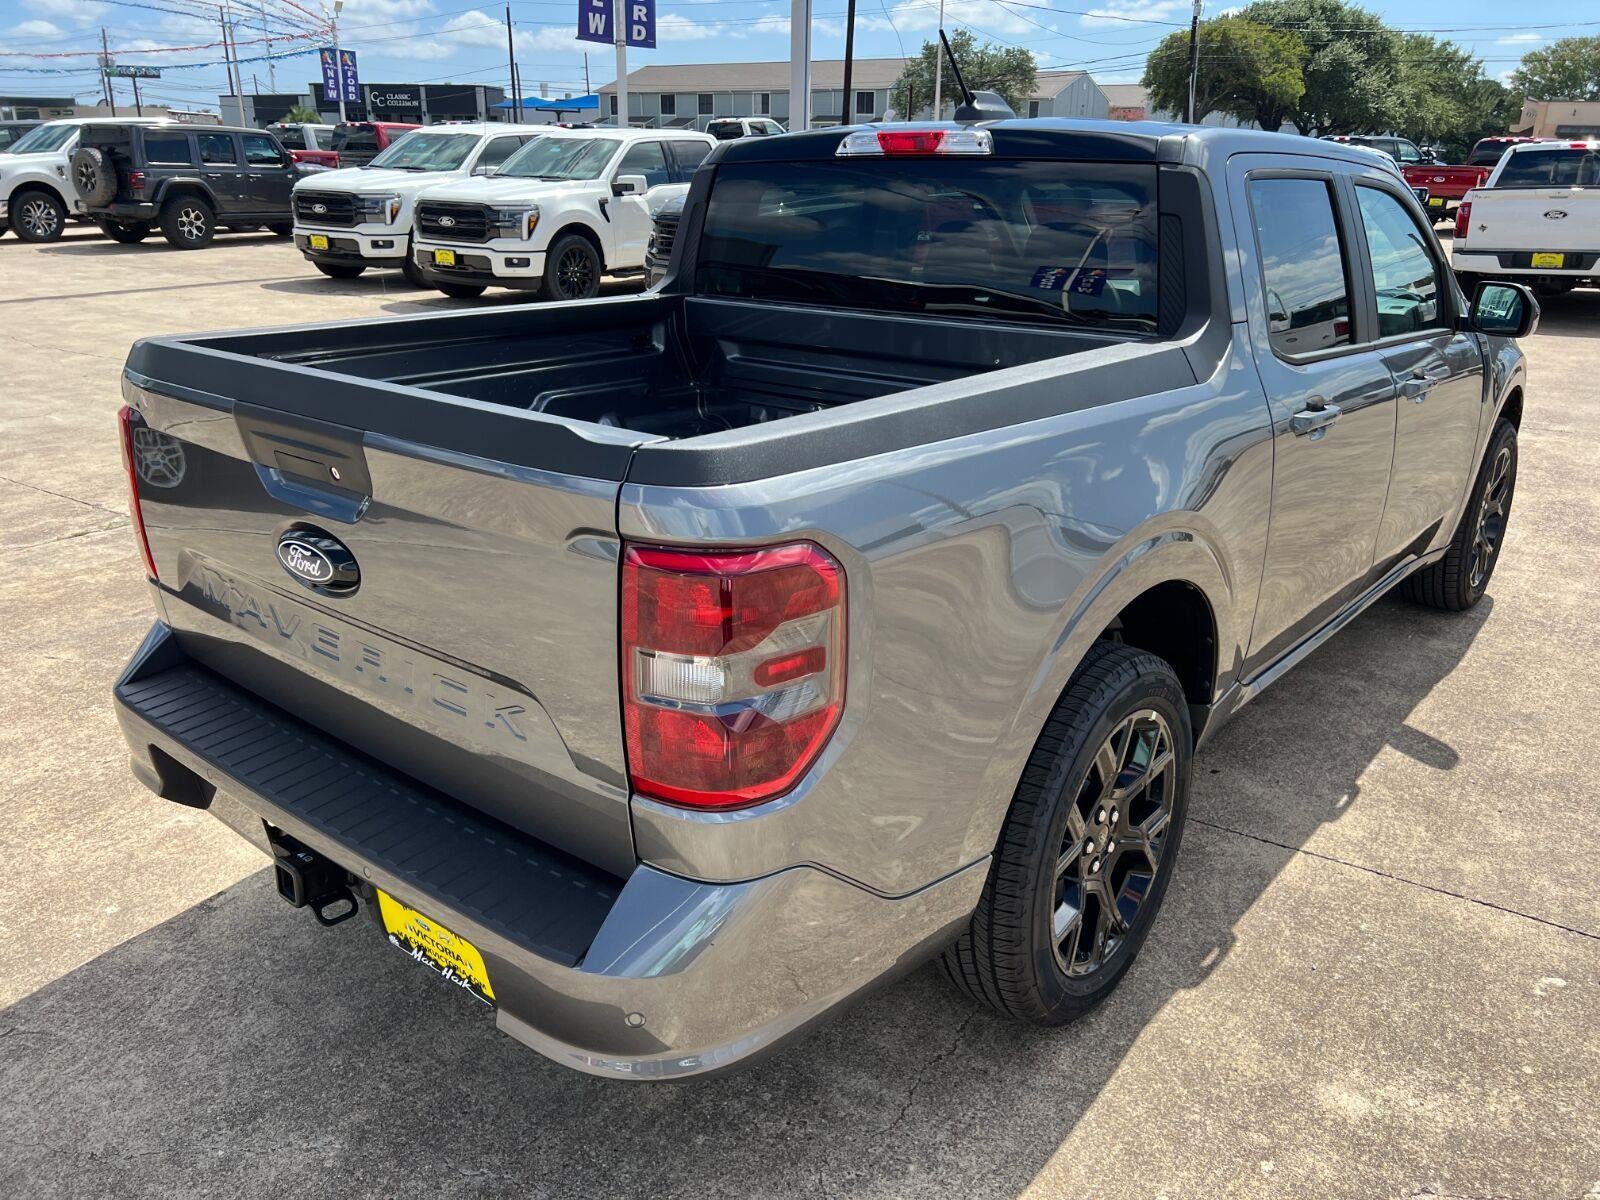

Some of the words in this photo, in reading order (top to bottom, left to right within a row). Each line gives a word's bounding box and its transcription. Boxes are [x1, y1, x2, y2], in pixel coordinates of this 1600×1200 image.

[632, 0, 648, 41] RD
[326, 68, 337, 99] NEW
[347, 70, 356, 100] FORD
[288, 544, 321, 577] Ford
[201, 566, 527, 742] MAVERICK
[412, 925, 465, 966] VICTORIA
[411, 947, 438, 972] Mac
[441, 967, 472, 988] Haik
